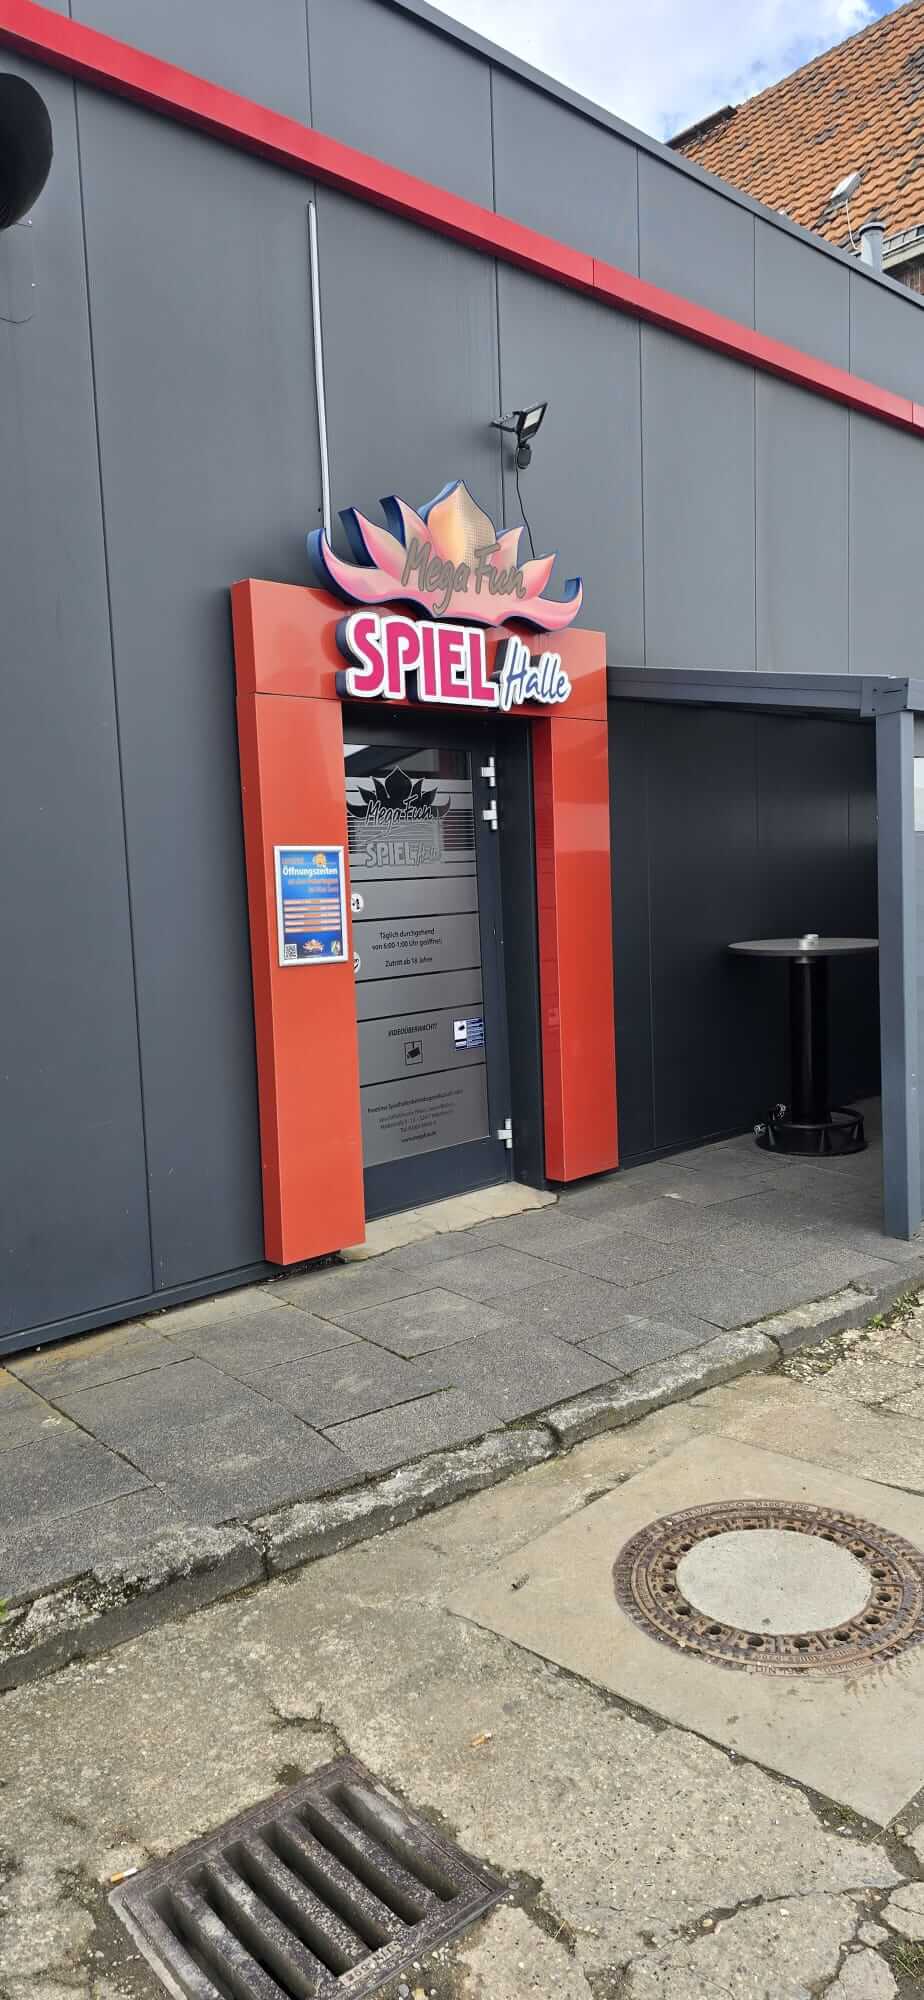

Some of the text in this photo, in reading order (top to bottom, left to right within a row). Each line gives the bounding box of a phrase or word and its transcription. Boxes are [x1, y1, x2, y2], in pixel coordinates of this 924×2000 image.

[401, 537, 527, 615] Mega Fun
[350, 614, 570, 707] SPIEL Halle
[366, 794, 433, 833] Mega Fun
[282, 864, 338, 877] Öffnungszeiten
[365, 841, 412, 868] SPIEL
[380, 931, 399, 939] Täglich
